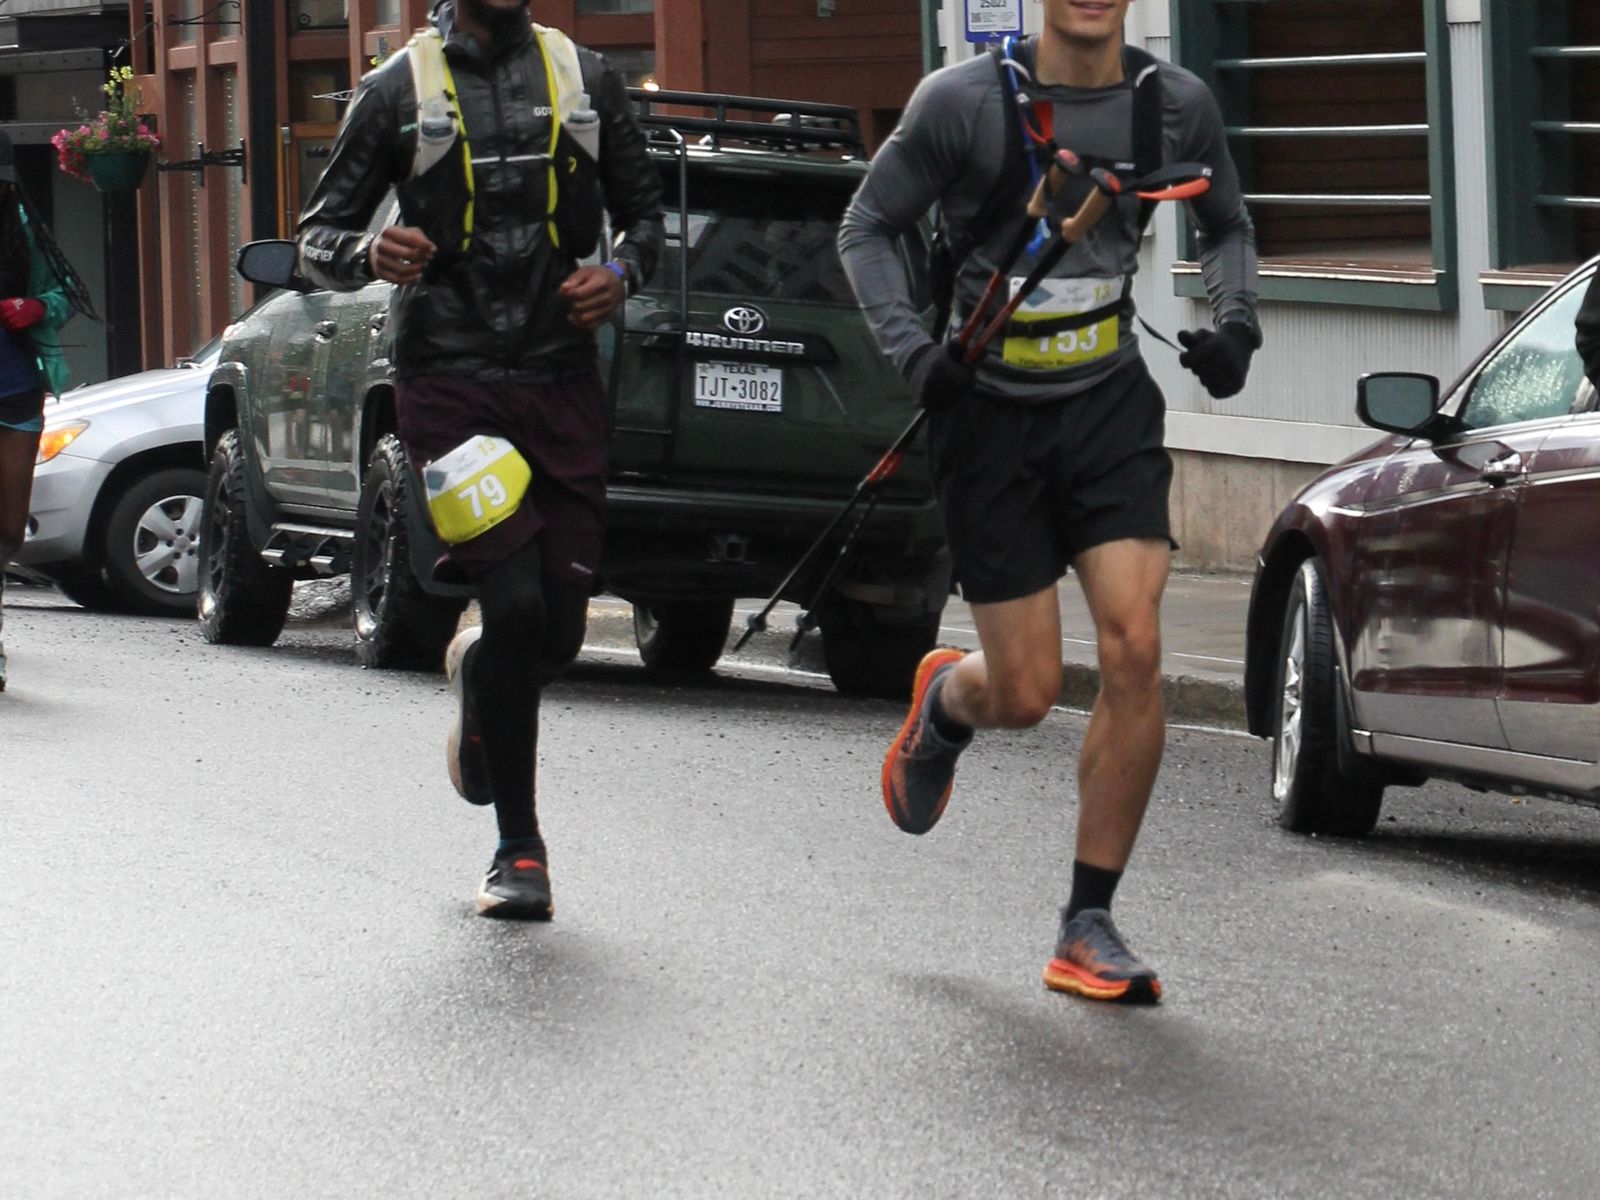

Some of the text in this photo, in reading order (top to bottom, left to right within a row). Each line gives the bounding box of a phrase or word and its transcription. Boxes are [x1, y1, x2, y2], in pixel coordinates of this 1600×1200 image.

[686, 332, 804, 354] 4RUNNER
[721, 364, 757, 375] TEXAS
[458, 473, 507, 519] 79
